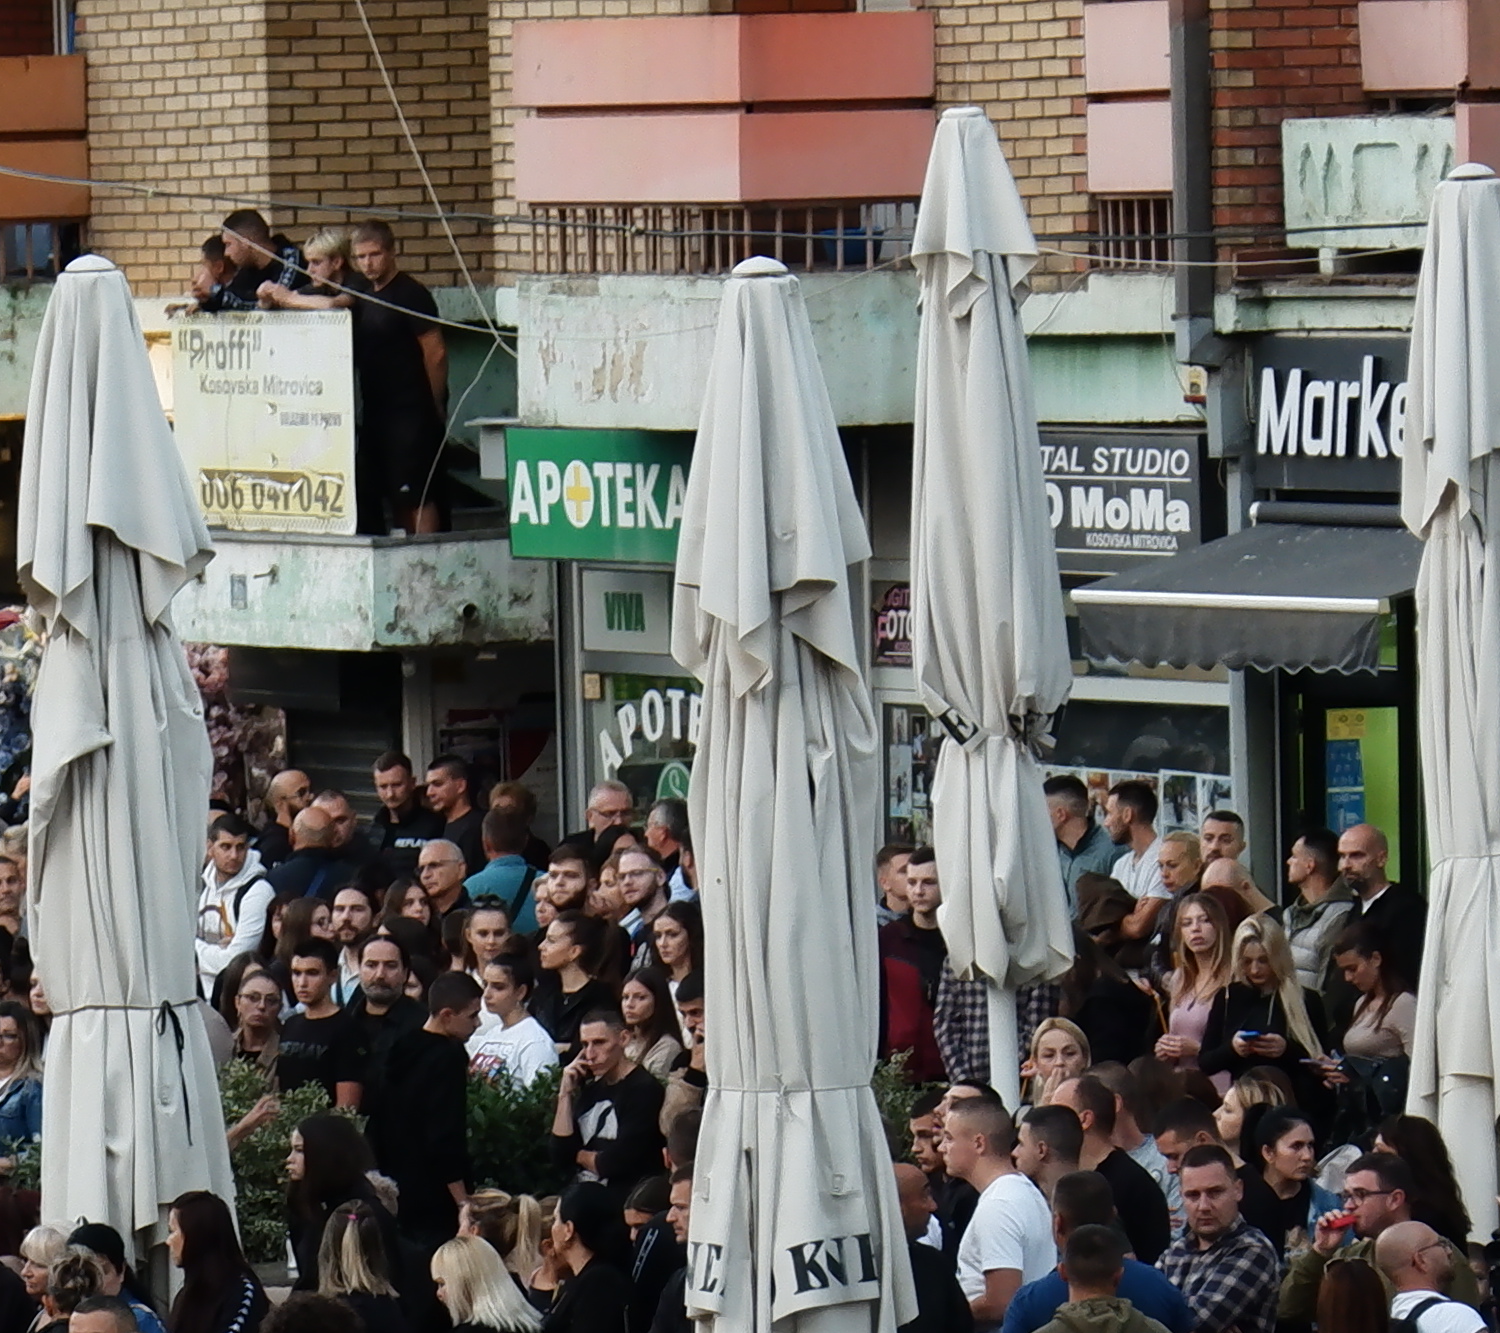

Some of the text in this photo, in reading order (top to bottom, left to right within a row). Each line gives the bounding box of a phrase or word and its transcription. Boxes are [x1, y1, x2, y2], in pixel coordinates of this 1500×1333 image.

[200, 373, 323, 397] Kosovska Mitrovica
[1092, 447, 1190, 475] STUDIO
[509, 459, 688, 530] APOTEKA
[1070, 486, 1190, 532] MoMa
[1085, 532, 1178, 550] KOSOVSKA MITROVICA
[603, 591, 646, 633] VIVA
